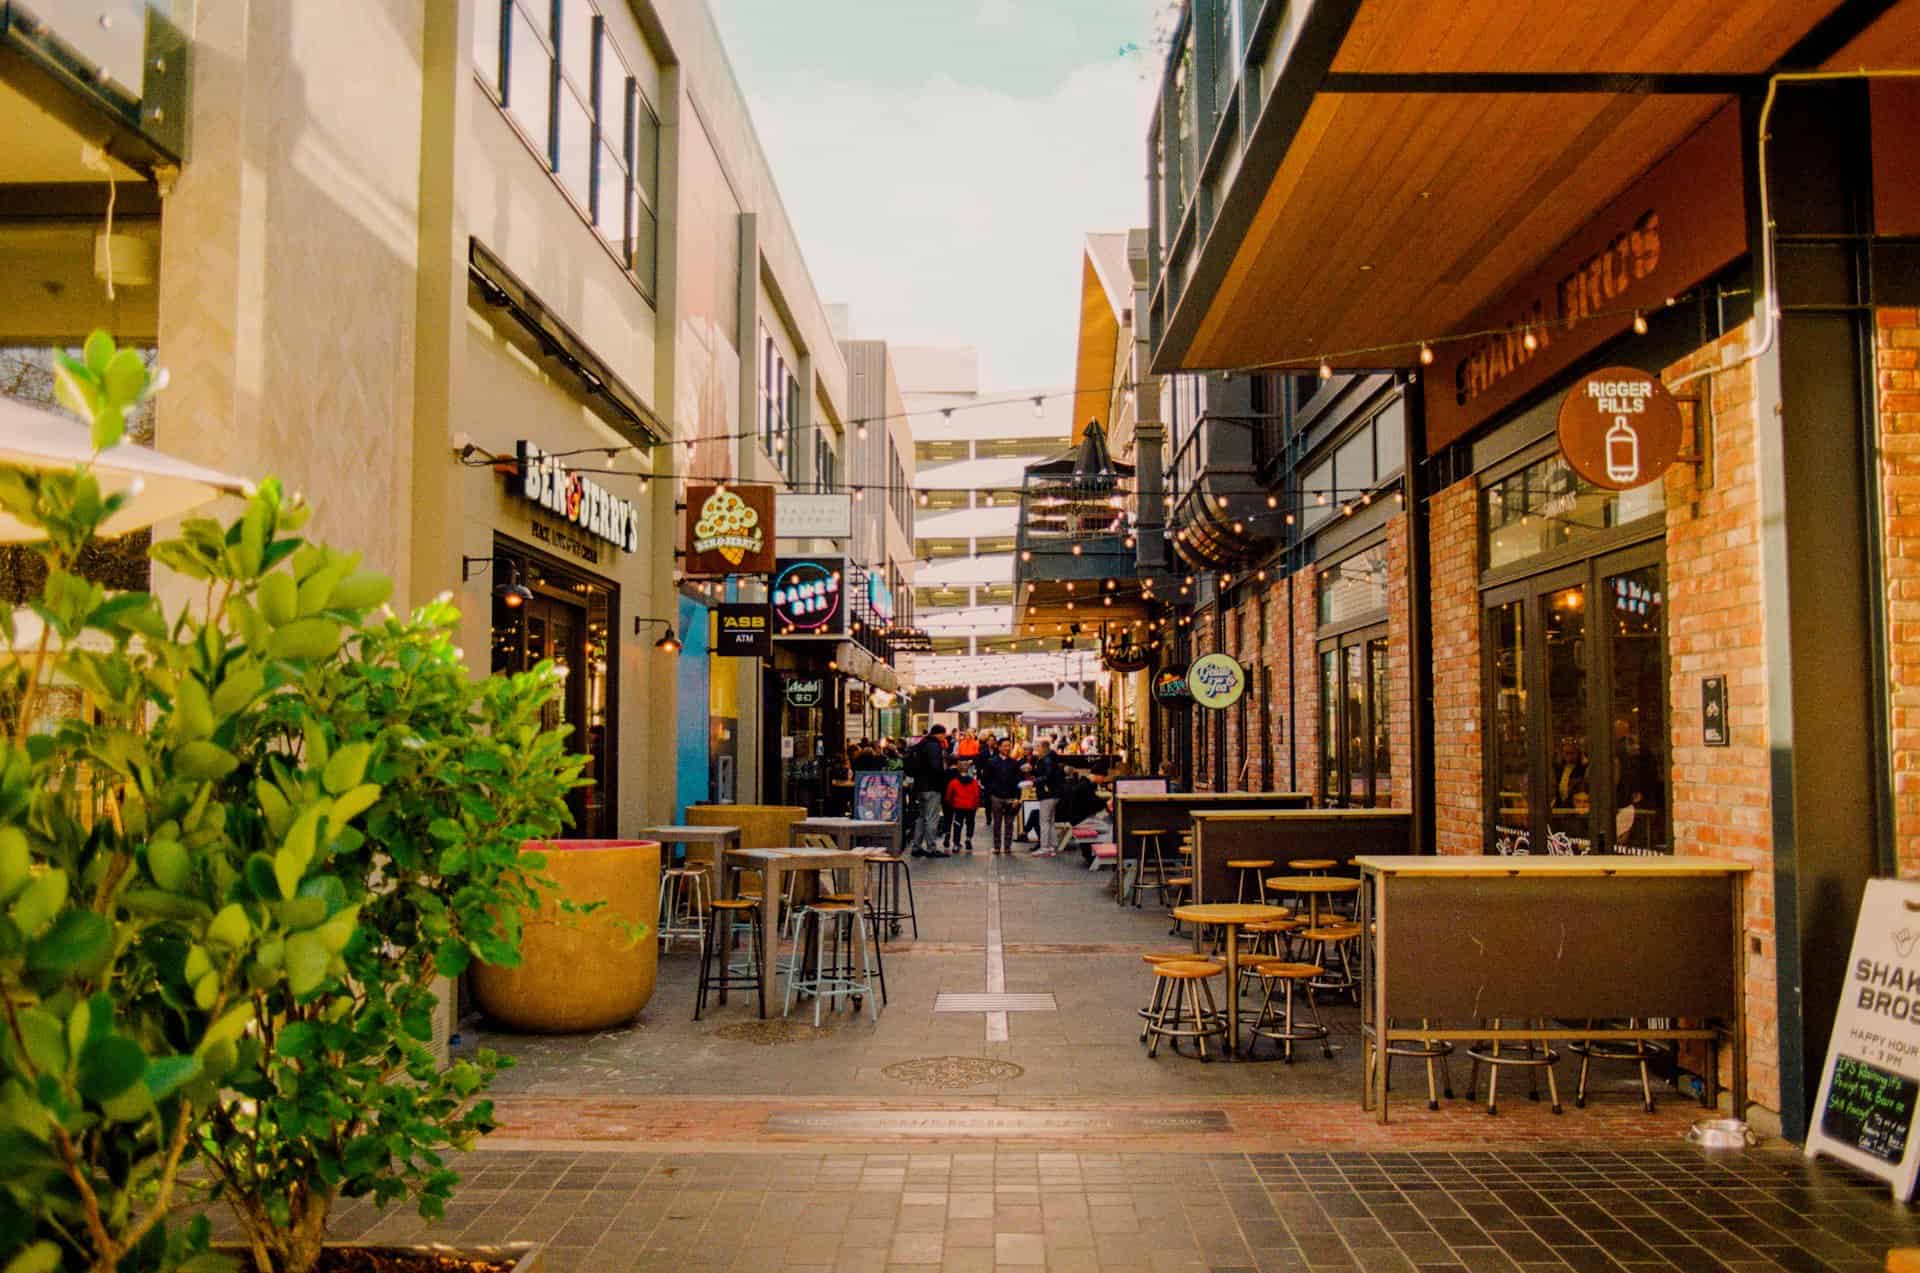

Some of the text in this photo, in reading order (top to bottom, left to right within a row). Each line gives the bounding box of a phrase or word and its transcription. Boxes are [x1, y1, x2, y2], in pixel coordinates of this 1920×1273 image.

[1587, 381, 1652, 398] RIGGER
[1597, 398, 1645, 413] FILLS
[735, 633, 753, 643] ATM
[1857, 986, 1920, 1024] BROS
[1850, 1027, 1887, 1045] HAPPY
[1888, 1039, 1919, 1056] HOUR
[1886, 1053, 1902, 1066] PM
